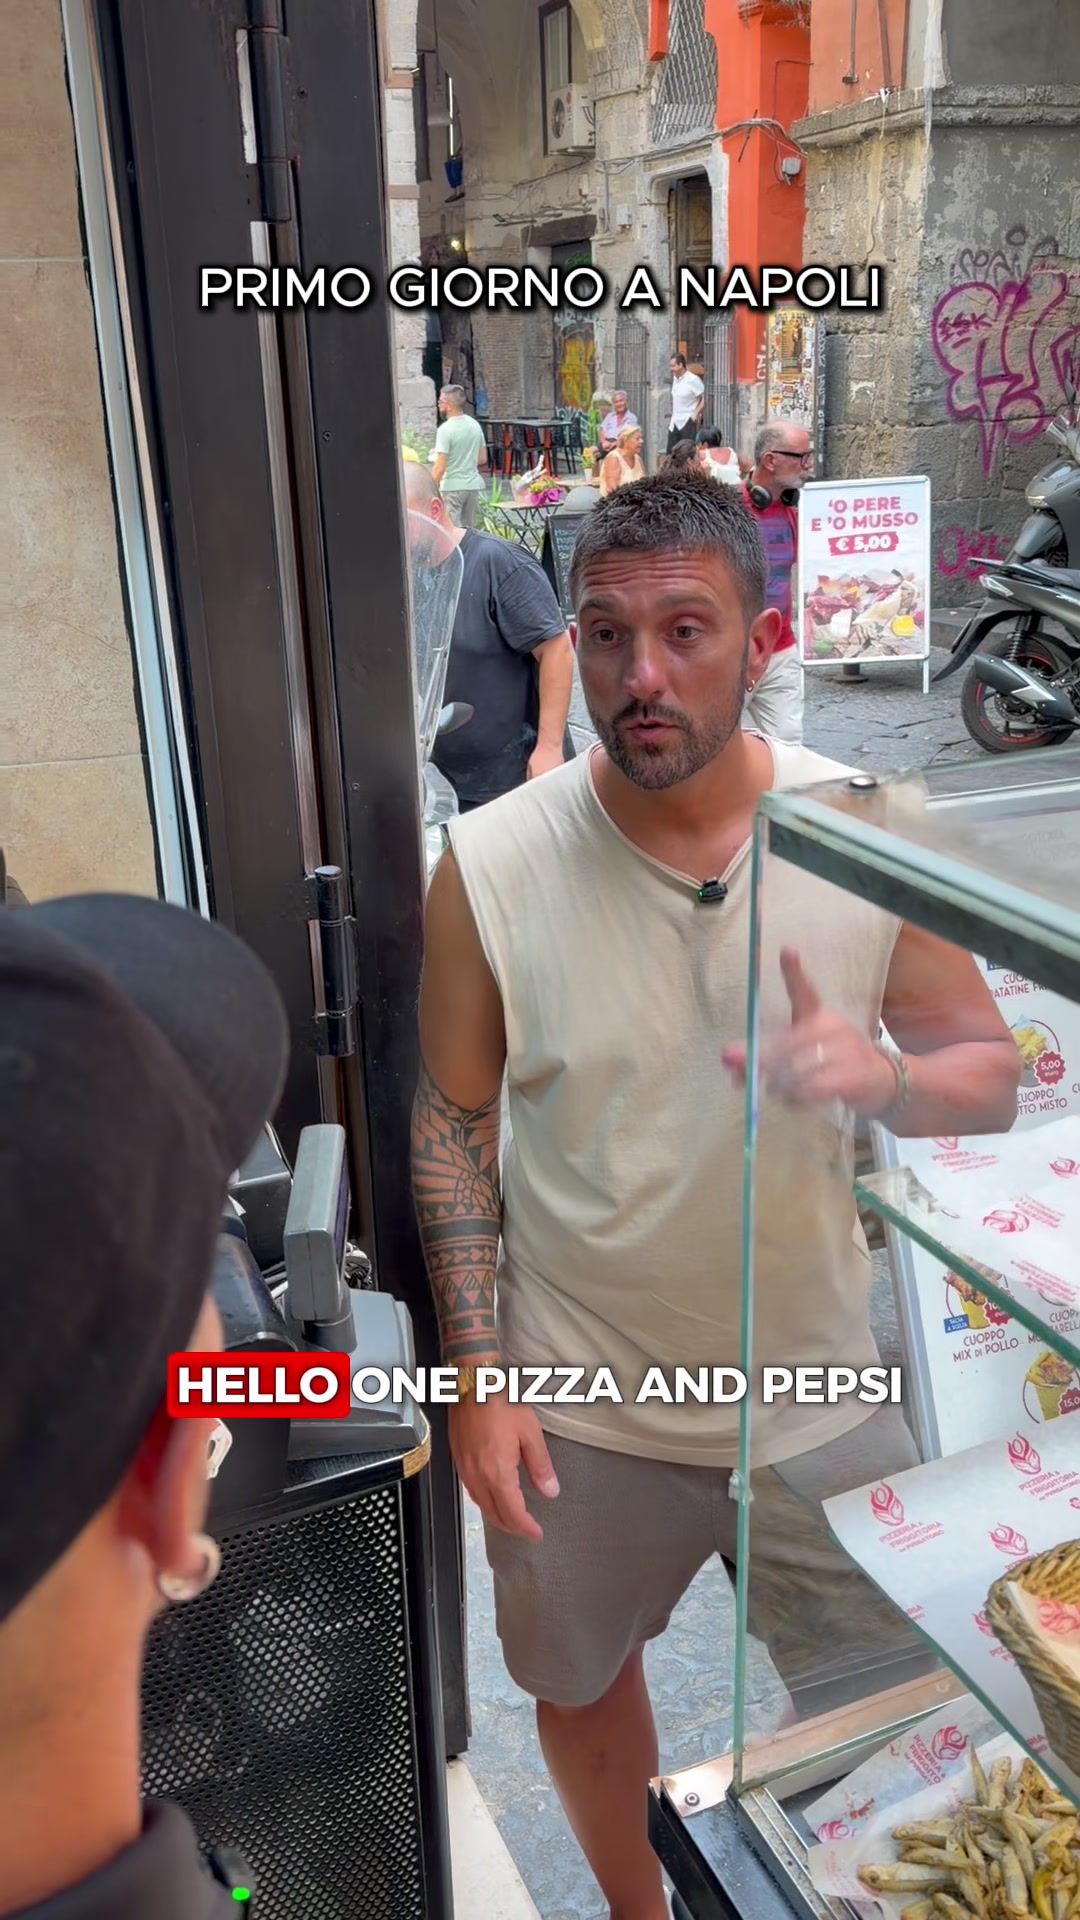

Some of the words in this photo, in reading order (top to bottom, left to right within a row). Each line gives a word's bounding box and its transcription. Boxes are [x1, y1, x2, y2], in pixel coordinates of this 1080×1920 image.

[828, 499, 848, 513] ‘O
[853, 496, 901, 512] PERE
[811, 518, 822, 531] E
[828, 516, 847, 530] ’O
[852, 512, 919, 529] MUSSO
[835, 537, 849, 551] €
[853, 535, 892, 552] 5,00
[991, 983, 1030, 998] ATATINE
[1040, 1059, 1061, 1070] 5,00
[1039, 1097, 1068, 1112] MISTO
[963, 1328, 1005, 1347] CUOPPO
[953, 1348, 972, 1362] MIX
[985, 1337, 1019, 1355] POLLO
[1018, 1471, 1056, 1491] PIZZERIA
[879, 1522, 919, 1544] PIZZERIA
[913, 1733, 942, 1773] PIZZERIA
